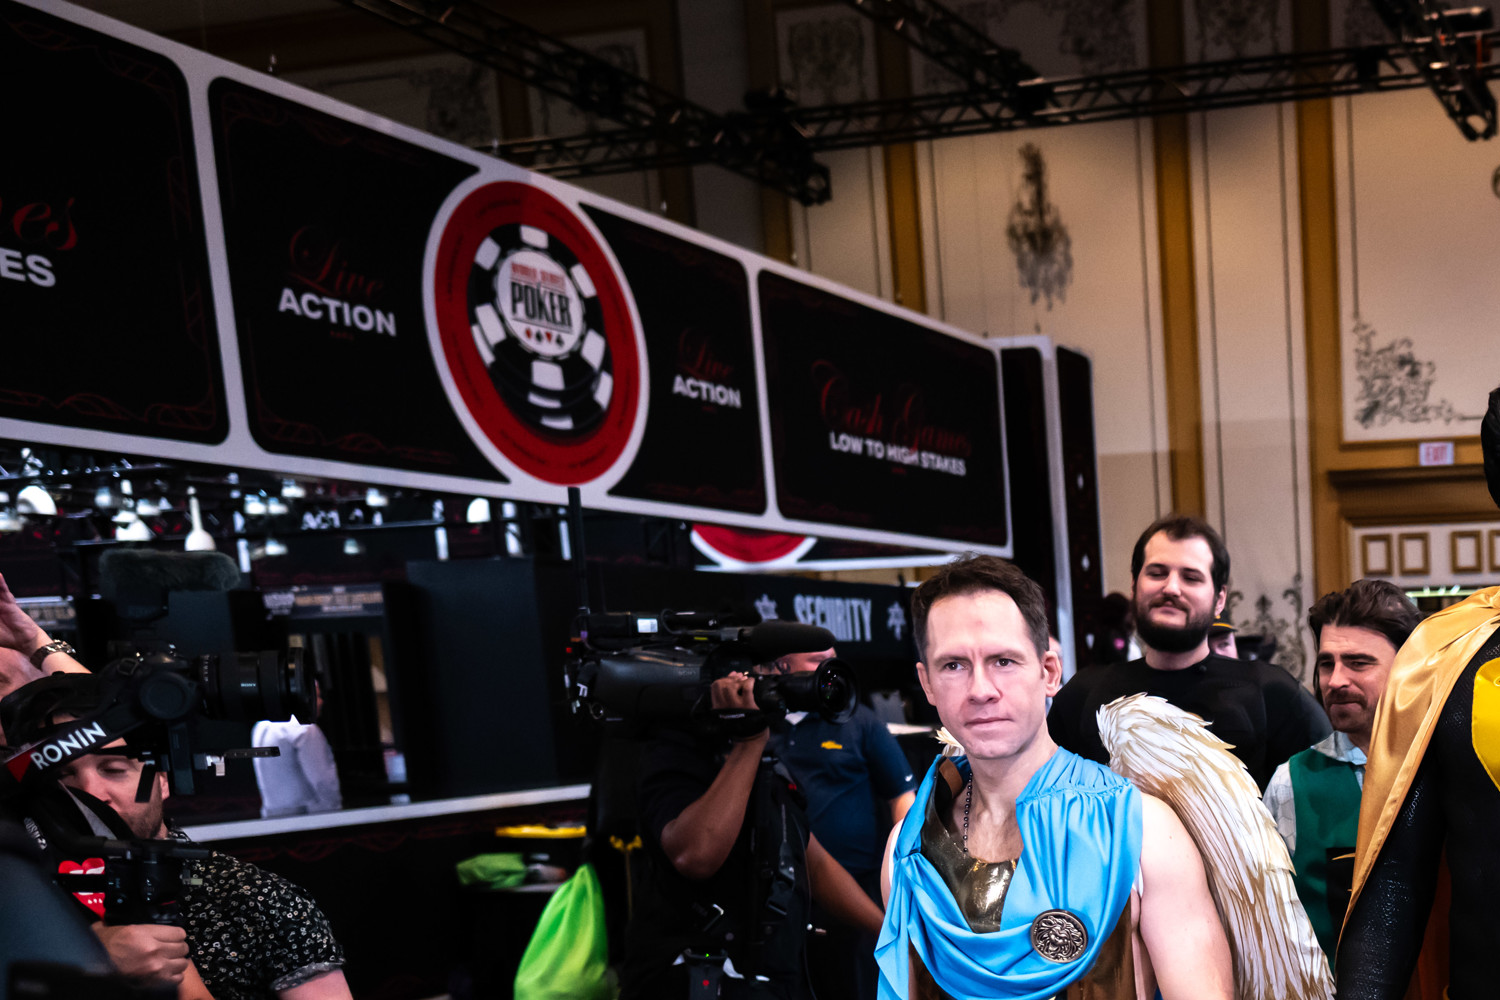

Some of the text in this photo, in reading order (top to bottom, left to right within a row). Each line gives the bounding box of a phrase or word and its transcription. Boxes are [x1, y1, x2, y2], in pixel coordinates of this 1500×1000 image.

[278, 287, 397, 337] ACTION
[511, 281, 573, 329] POKER
[672, 373, 742, 409] ACTION
[829, 430, 967, 477] LOW TO HIGH STAKES
[793, 593, 872, 642] SECURITY
[30, 721, 107, 770] RONIN
